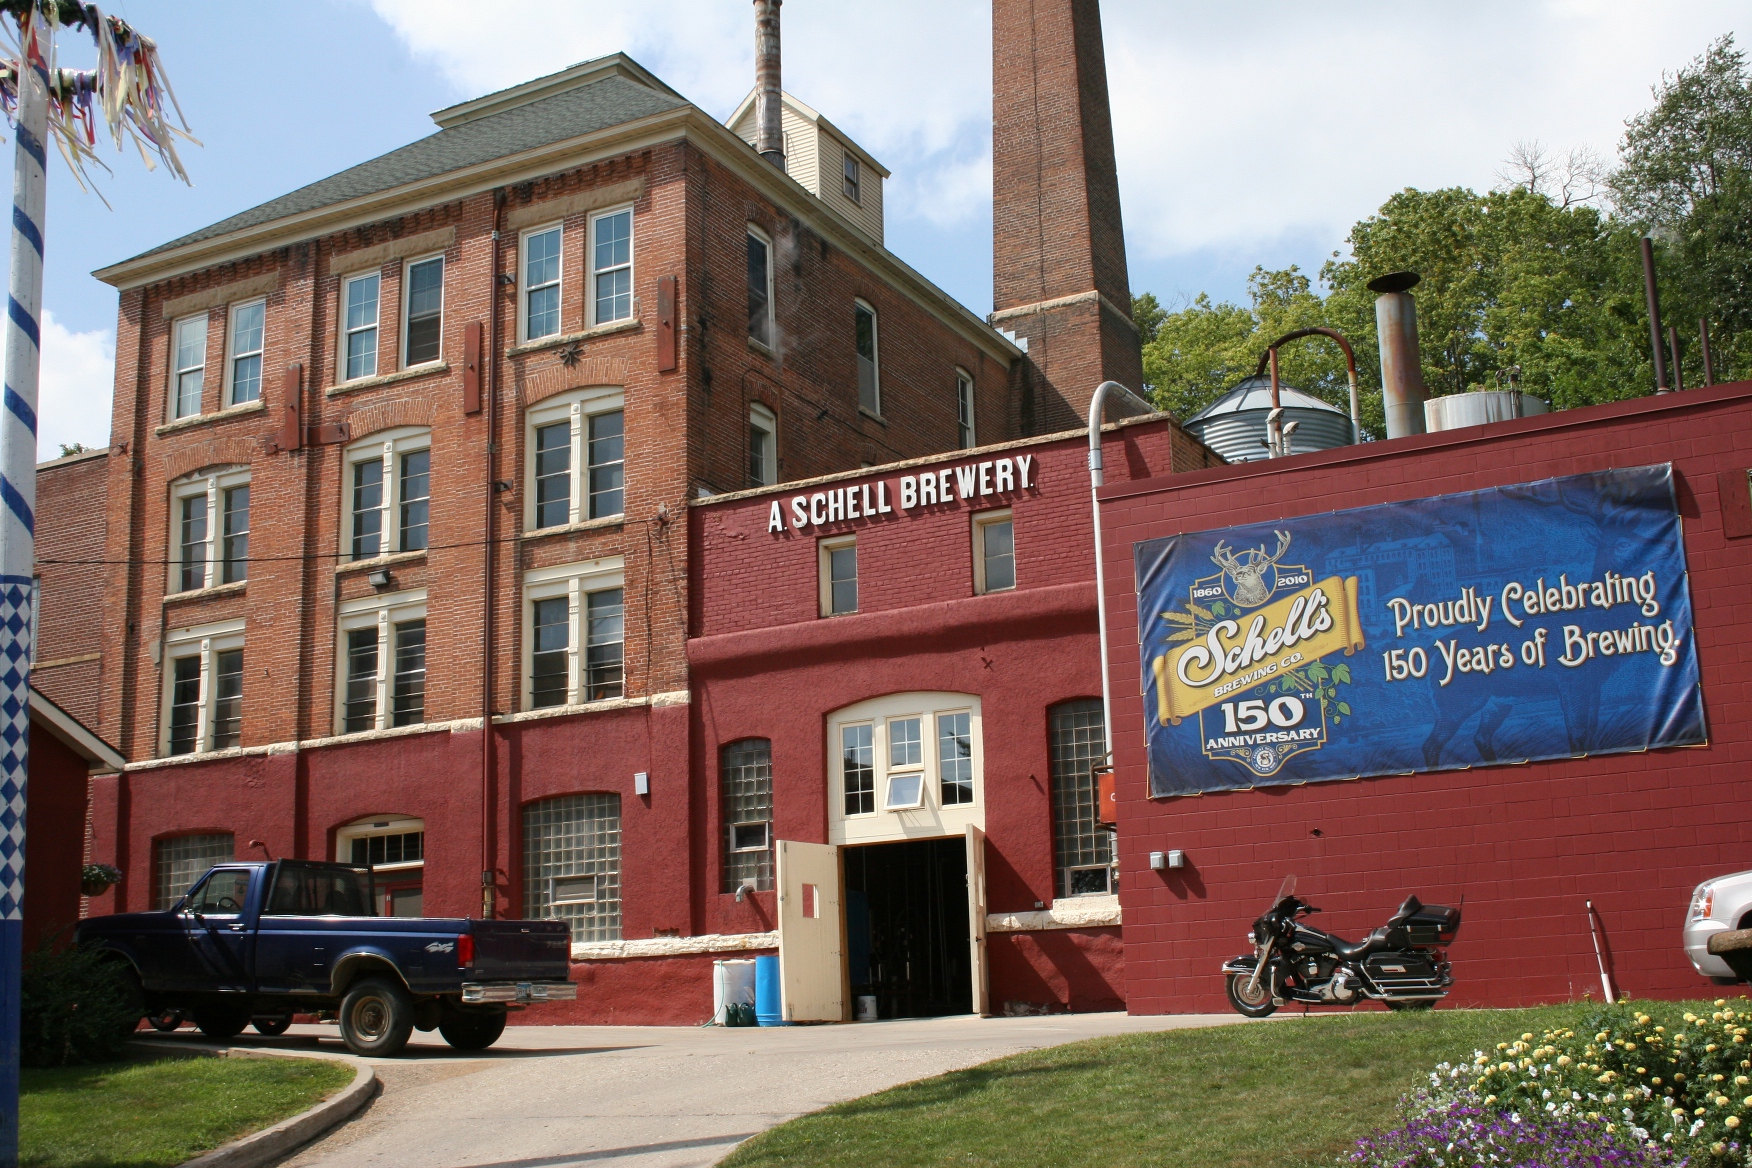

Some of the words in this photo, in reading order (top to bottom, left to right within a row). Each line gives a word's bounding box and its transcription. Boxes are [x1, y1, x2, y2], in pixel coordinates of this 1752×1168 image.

[792, 480, 891, 529] SCHELL
[1193, 586, 1222, 598] 1860
[1277, 575, 1308, 587] 2010
[1386, 586, 1493, 637] Proudly
[1501, 570, 1660, 628] Celebrating
[1177, 588, 1333, 687] Schell's
[1382, 646, 1428, 682] 150
[1433, 639, 1515, 687] Years
[1521, 627, 1548, 668] of
[1214, 662, 1278, 698] BREWING
[1280, 652, 1304, 668] CO.
[1206, 727, 1321, 750] ANNIVERSARY
